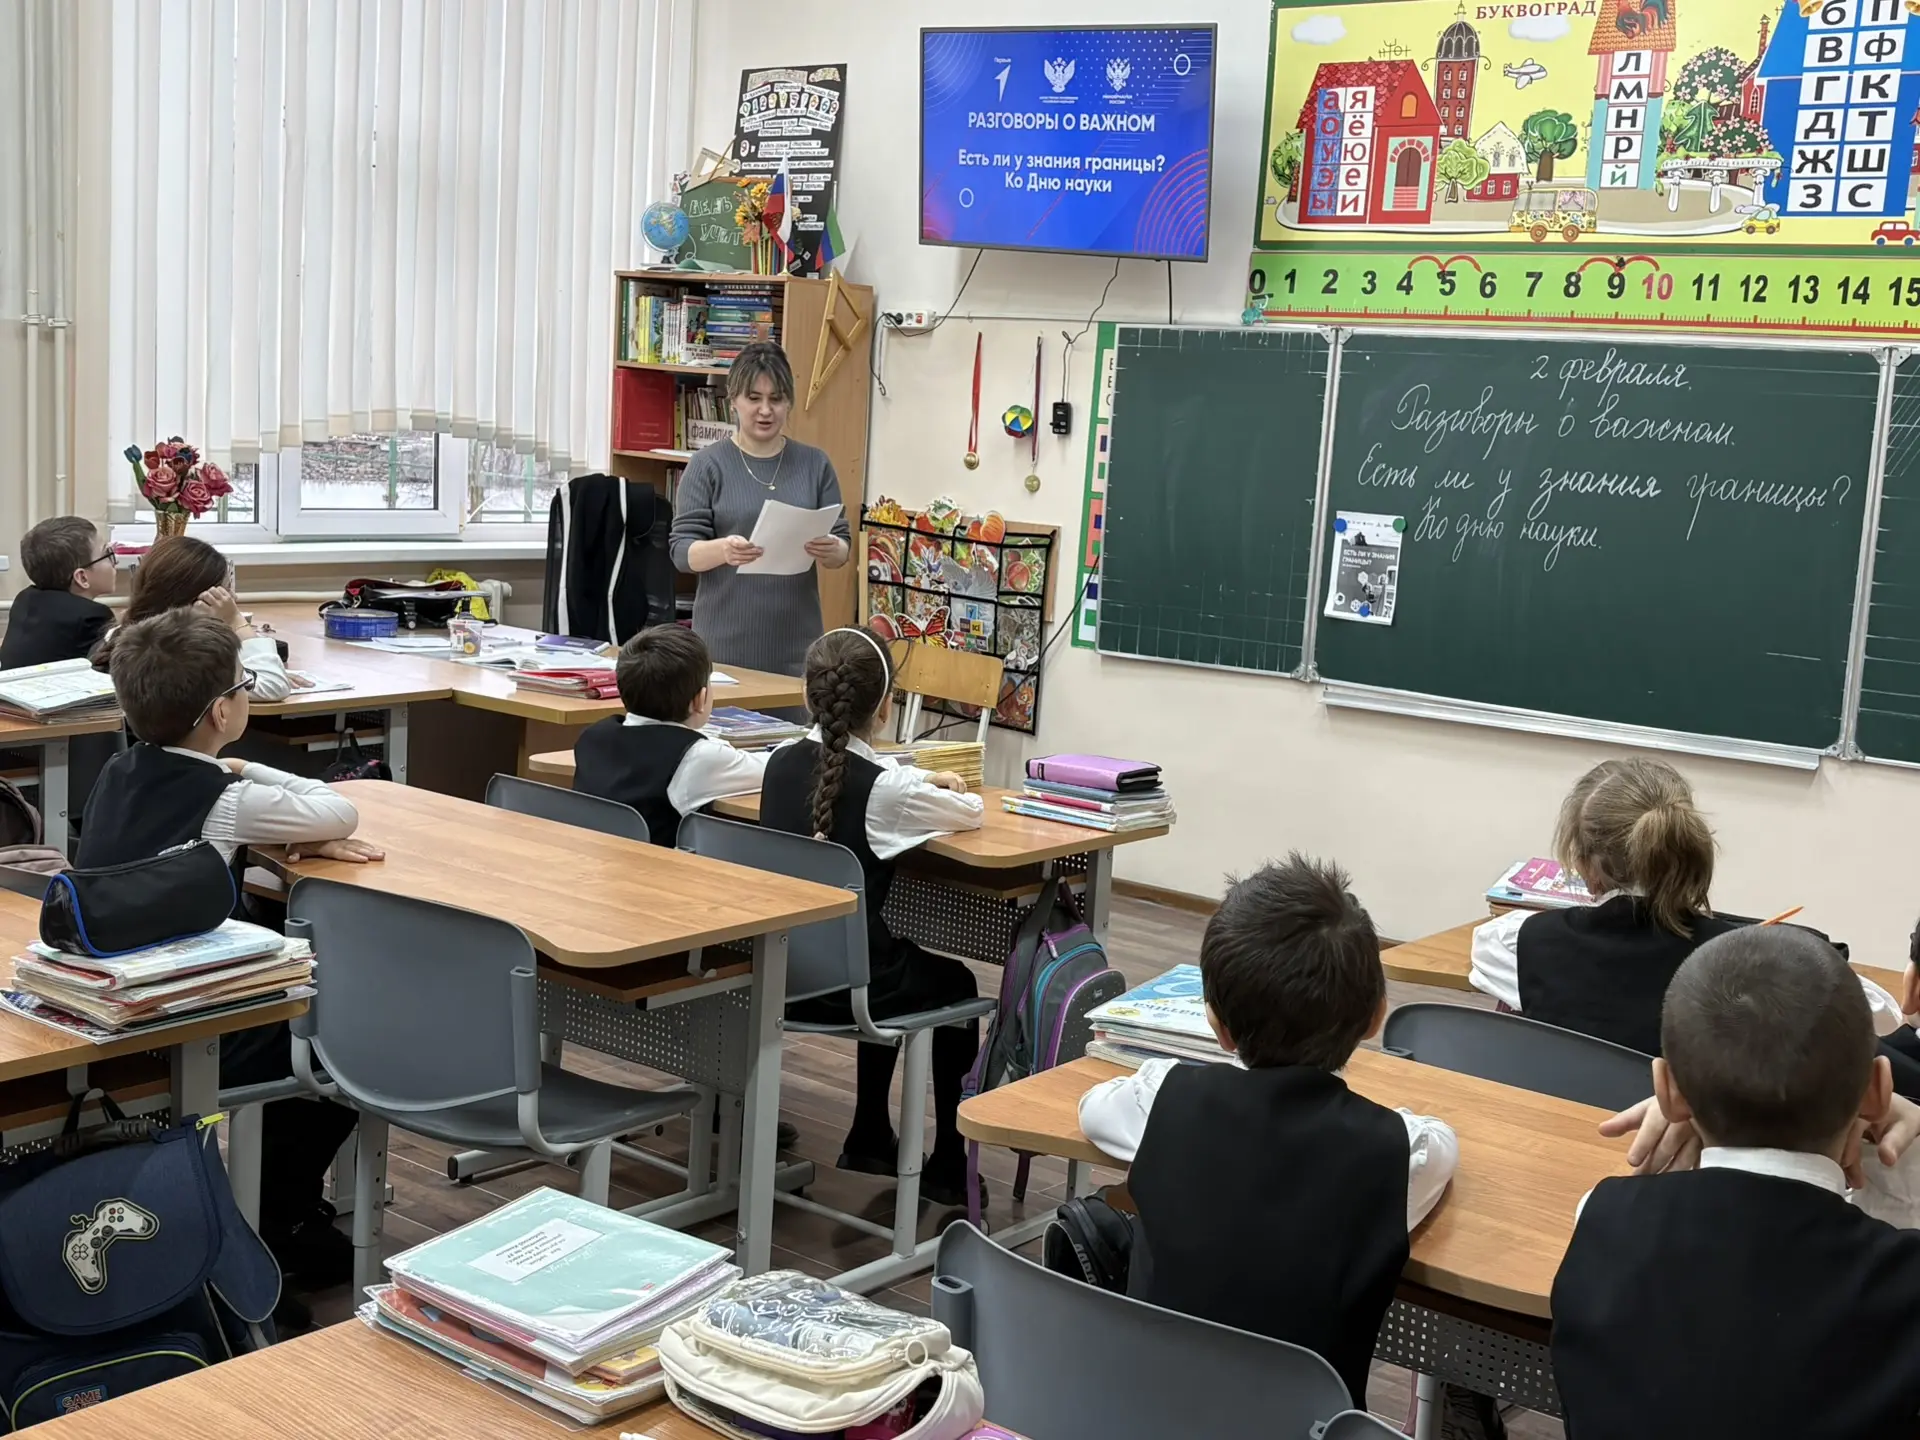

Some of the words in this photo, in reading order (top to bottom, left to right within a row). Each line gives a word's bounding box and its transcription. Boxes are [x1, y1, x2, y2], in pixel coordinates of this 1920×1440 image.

[1475, 0, 1597, 20] БУКВОГРАД
[1323, 91, 1339, 110] а
[1349, 90, 1367, 109] я
[968, 112, 1058, 130] РАЗГОВОРЫ
[1063, 114, 1076, 130] О
[1080, 114, 1155, 132] ВАЖНОМ
[1348, 114, 1365, 137] ё
[959, 149, 989, 165] Есть
[993, 154, 1010, 166] ли
[1014, 154, 1023, 170] у
[1027, 154, 1081, 170] знания
[1085, 155, 1165, 174] границы?
[1320, 141, 1337, 162] у
[1344, 142, 1366, 162] ю
[1005, 172, 1023, 188] Ко
[1027, 173, 1060, 192] Дню
[1065, 178, 1112, 195] науки
[1317, 171, 1334, 188] э
[1344, 168, 1361, 187] е
[1312, 192, 1334, 210] ы
[1340, 194, 1359, 213] и
[1250, 269, 1266, 294] 0
[1285, 268, 1297, 294] 1
[1321, 269, 1339, 294] 2
[1361, 270, 1377, 295] 3
[1396, 270, 1414, 296] 4
[1437, 270, 1456, 296] 5
[1480, 271, 1497, 298] 6
[1525, 271, 1543, 298] 7
[1563, 271, 1581, 298] 8
[1607, 272, 1626, 299] 9
[1641, 273, 1673, 300] 10
[1692, 273, 1720, 301] 11
[1740, 274, 1768, 303] 12
[1788, 275, 1819, 304] 13
[1837, 276, 1870, 305] 14
[1888, 277, 1920, 307] 15
[1530, 355, 1549, 380] 2
[1391, 384, 1540, 460] Разговоры
[1358, 443, 1418, 488] Есть
[1434, 469, 1475, 490] ли
[1487, 468, 1512, 520] у
[1527, 467, 1661, 520] знания
[1686, 473, 1851, 541] границы?
[1414, 496, 1449, 542] Ко
[62, 1389, 102, 1408] GAME
